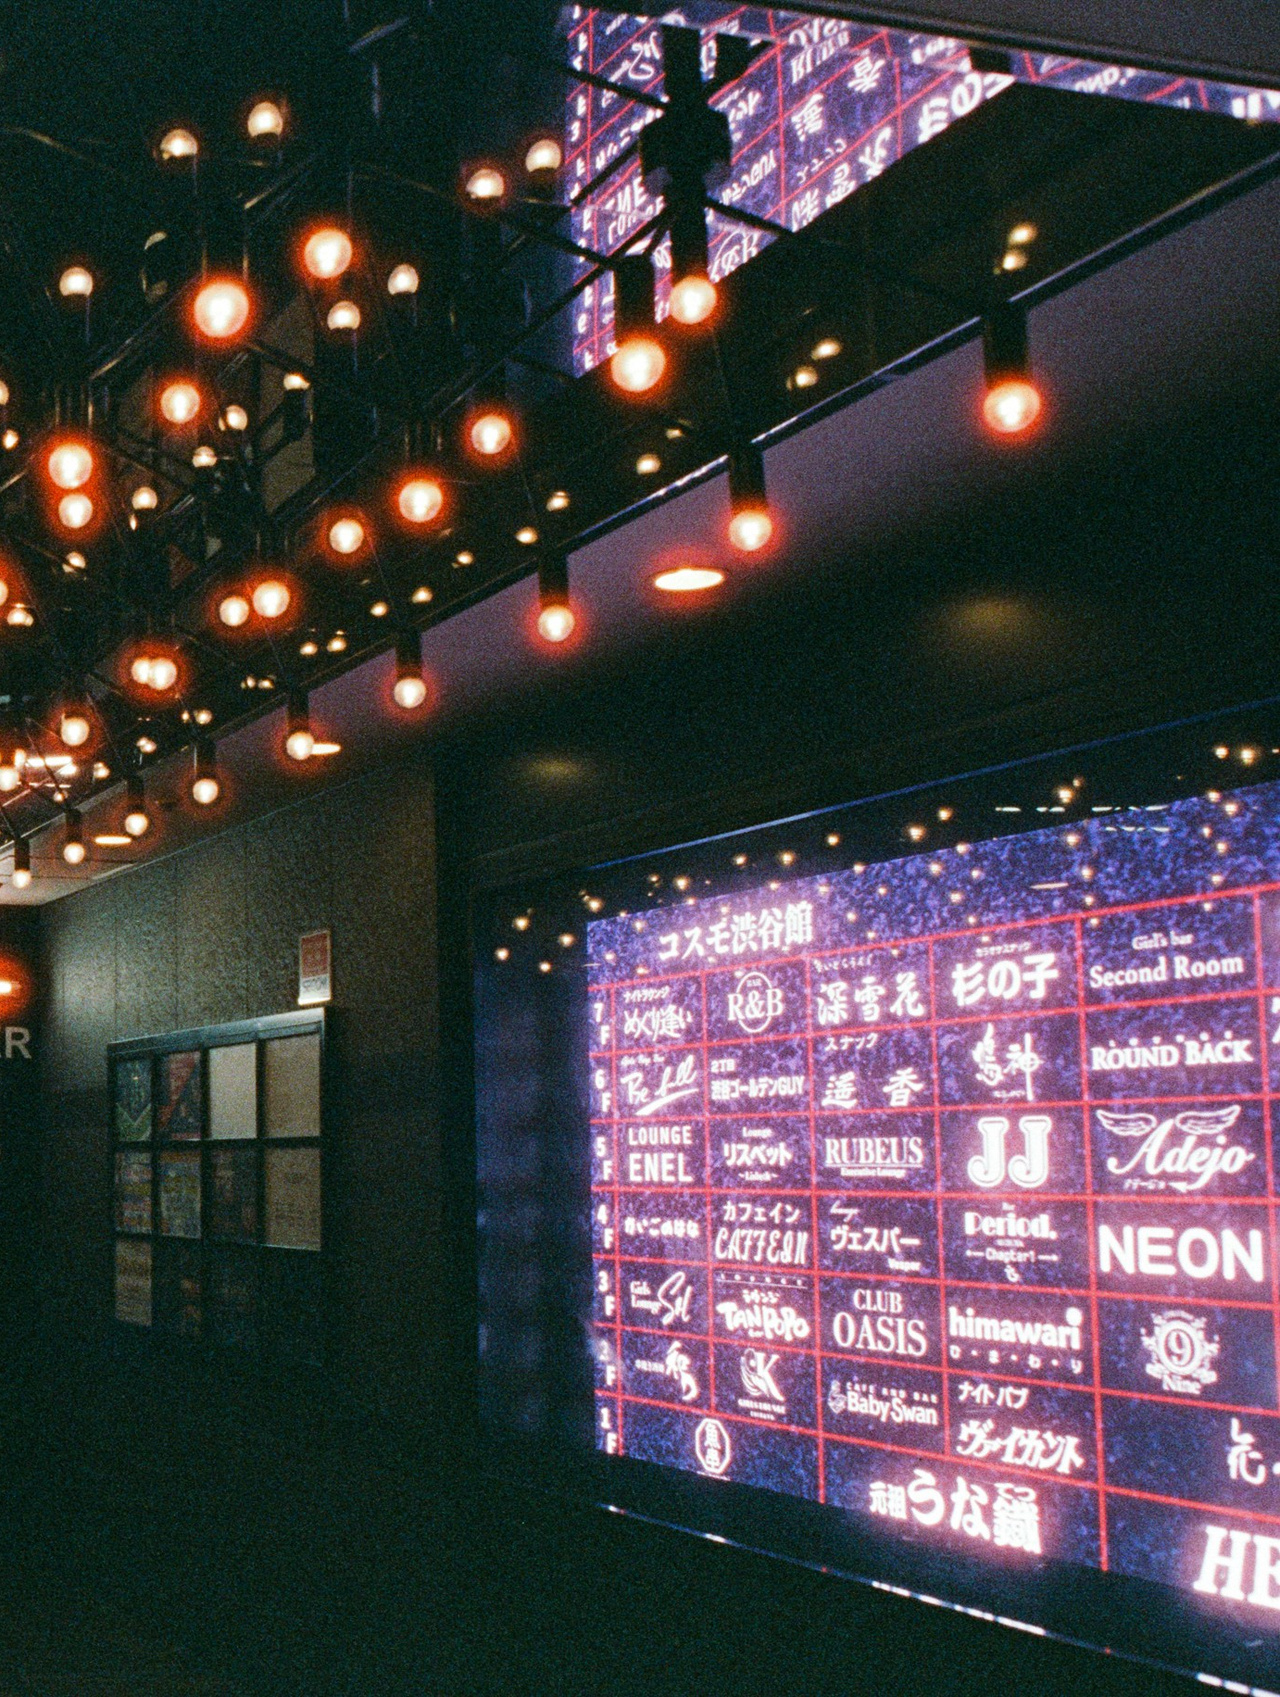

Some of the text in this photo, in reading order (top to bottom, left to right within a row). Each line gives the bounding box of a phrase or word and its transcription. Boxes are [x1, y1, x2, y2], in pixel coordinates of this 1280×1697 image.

[658, 900, 813, 961] コスモ渋谷館
[951, 952, 1059, 1006] 杉の子
[1089, 955, 1245, 989] Second Room
[727, 988, 784, 1021] R&B
[824, 1032, 879, 1051] スナック
[1091, 1035, 1255, 1071] ROUND BACK
[594, 1069, 611, 1113] 6F
[628, 1126, 693, 1146] LOUNGE
[824, 1136, 925, 1164] RUBEUS
[967, 1116, 1052, 1189] JJ
[1107, 1118, 1256, 1193] Adejo
[596, 1137, 612, 1182] 5F
[628, 1153, 694, 1184] ENEL
[597, 1204, 614, 1250] 4F
[723, 1200, 801, 1224] カフェイン
[830, 1224, 921, 1254] ヴェスパー
[1098, 1224, 1265, 1283] NEON
[598, 1270, 615, 1317] 3F
[852, 1289, 903, 1315] CLUB
[715, 1301, 810, 1341] TANPOPO
[833, 1312, 928, 1358] OASIS
[949, 1306, 1083, 1349] himawari
[600, 1407, 617, 1455] 1F
